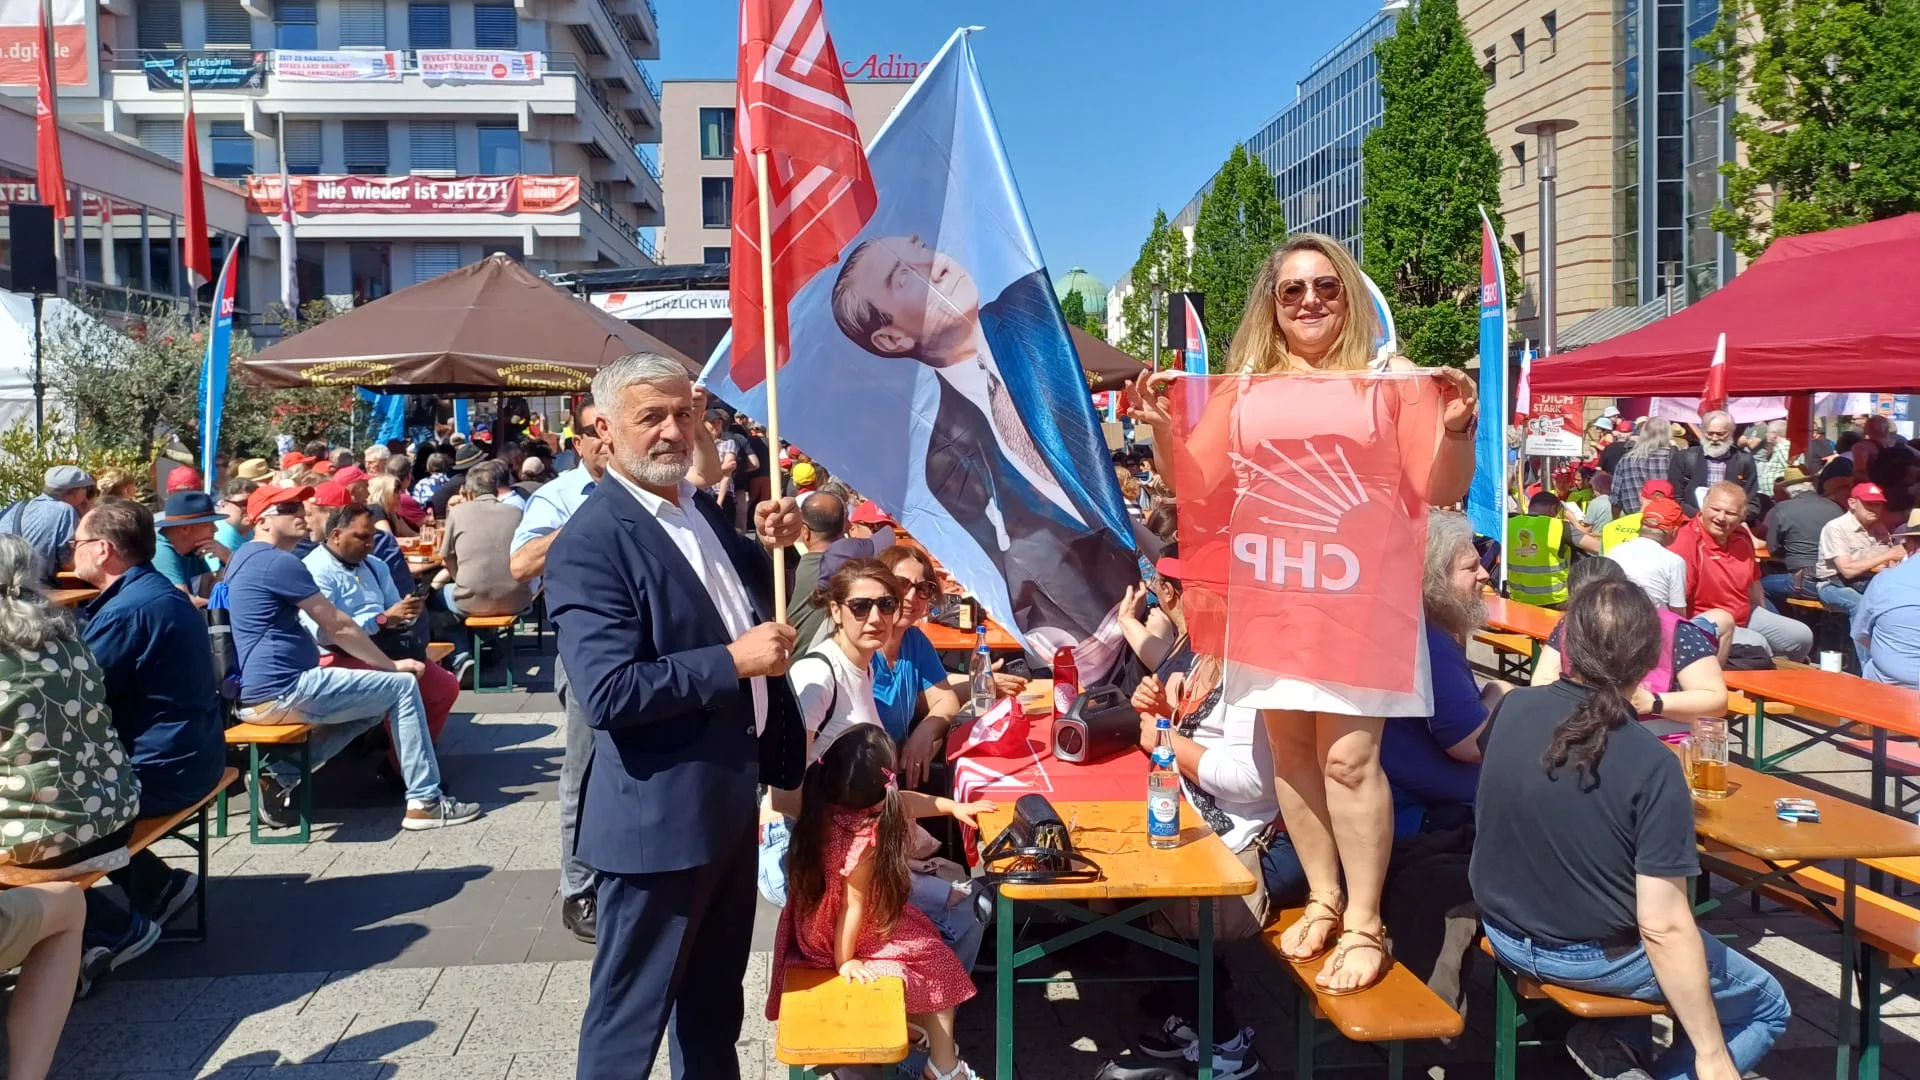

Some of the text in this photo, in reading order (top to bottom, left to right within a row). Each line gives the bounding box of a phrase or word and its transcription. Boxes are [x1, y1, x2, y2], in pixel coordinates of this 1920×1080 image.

[317, 182, 346, 200] Nie
[352, 182, 410, 200] wieder
[415, 182, 438, 200] ist
[221, 297, 234, 314] DG
[645, 298, 708, 310] HERZLICH
[496, 363, 593, 385] Reisegastronomie
[507, 374, 581, 391] Morawski
[1533, 403, 1563, 413] STARK
[1541, 394, 1574, 405] DICH
